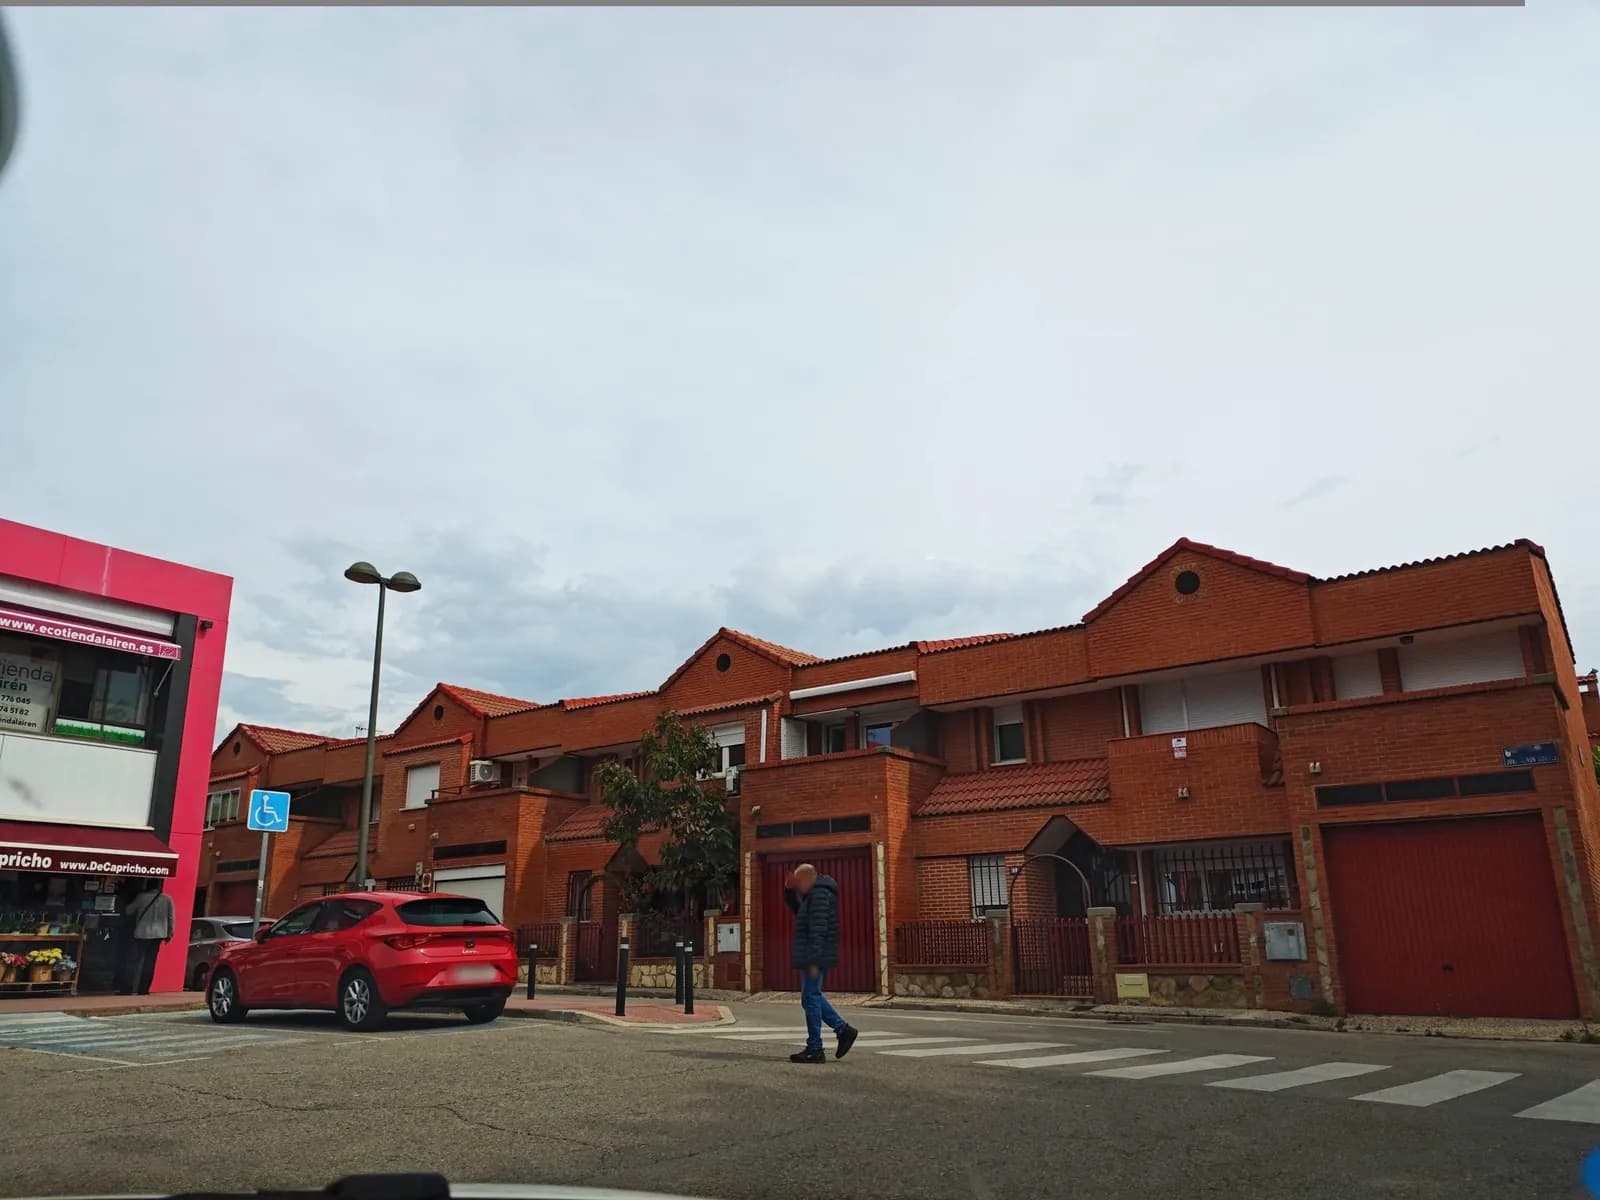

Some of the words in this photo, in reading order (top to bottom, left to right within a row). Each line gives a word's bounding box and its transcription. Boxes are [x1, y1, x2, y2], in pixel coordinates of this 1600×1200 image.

[0, 618, 154, 654] www.ecotiendalairen.es
[0, 659, 53, 682] ienda
[60, 861, 169, 875] www.DeCapricho.com
